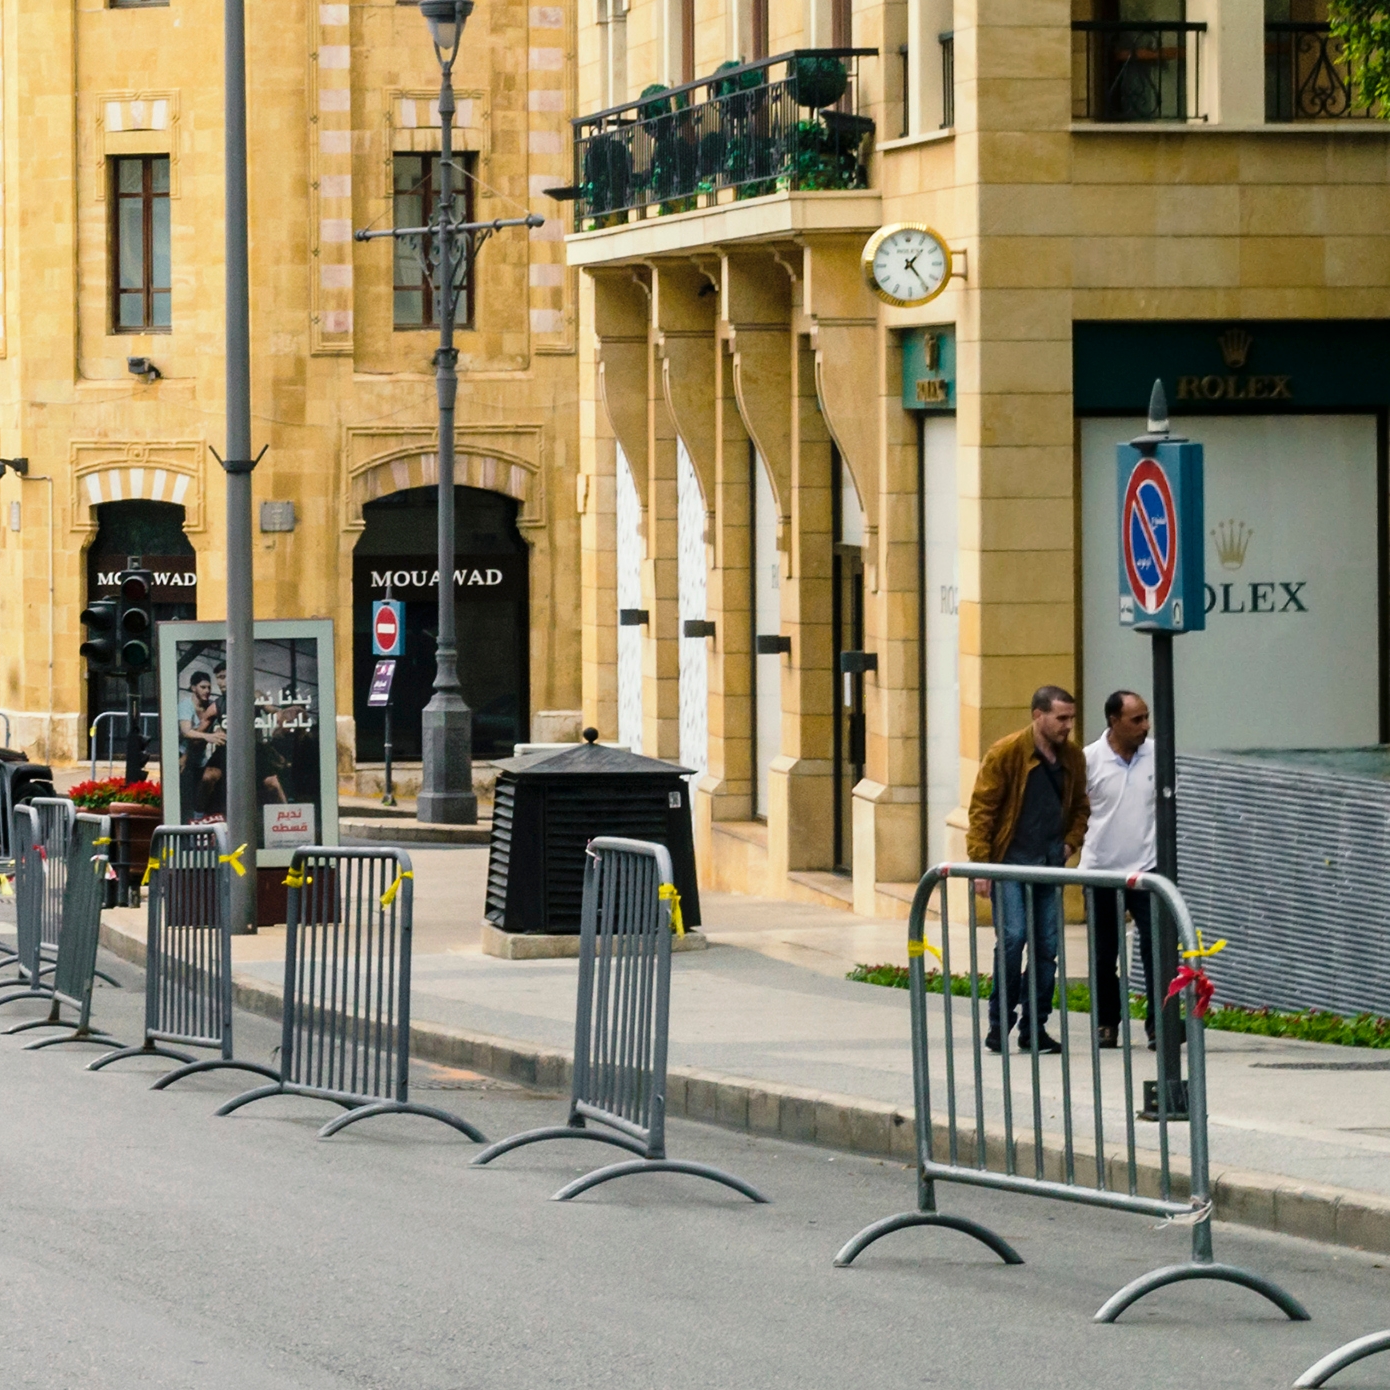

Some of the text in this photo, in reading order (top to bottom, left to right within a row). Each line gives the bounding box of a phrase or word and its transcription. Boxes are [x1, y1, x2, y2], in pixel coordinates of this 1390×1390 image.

[1176, 374, 1293, 399] ROLEX
[97, 572, 197, 586] MOWAD
[1204, 582, 1308, 614] LEX
[282, 712, 313, 733] باب
[277, 808, 302, 821] نديم
